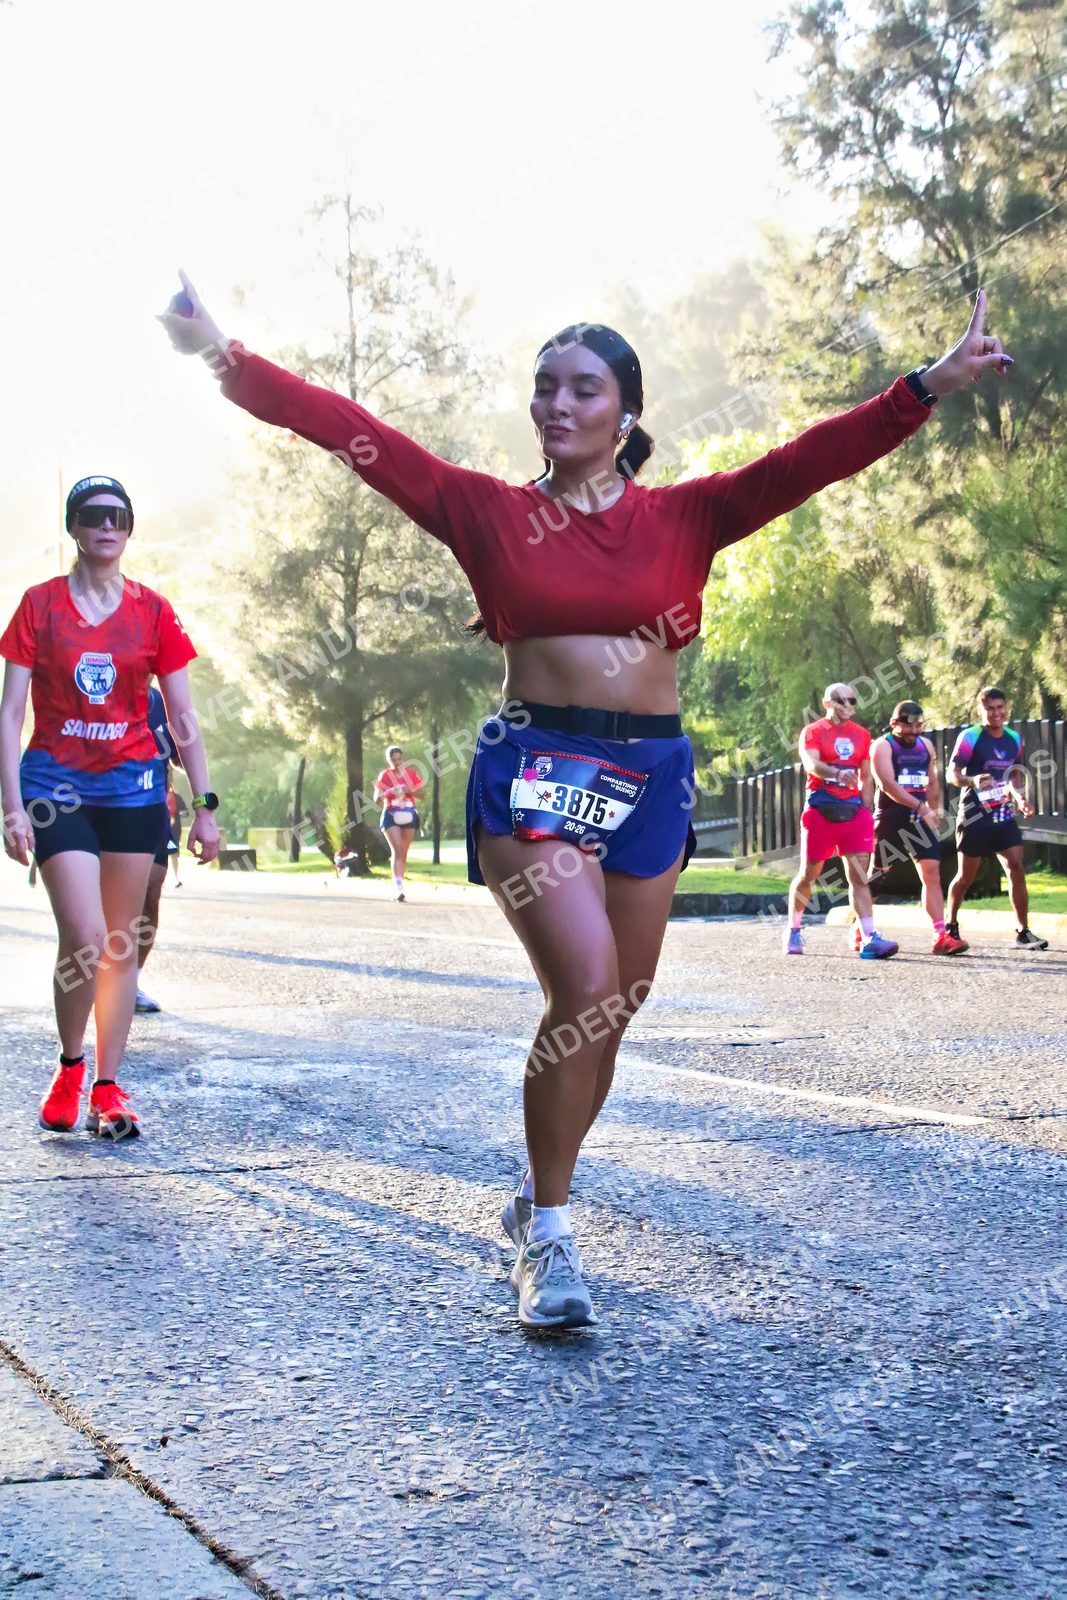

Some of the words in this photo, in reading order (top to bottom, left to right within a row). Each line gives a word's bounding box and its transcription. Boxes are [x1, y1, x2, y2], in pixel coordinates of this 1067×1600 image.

[600, 774, 638, 791] COMPARTIMOS
[615, 785, 636, 798] BUENO
[552, 785, 608, 825] 3875
